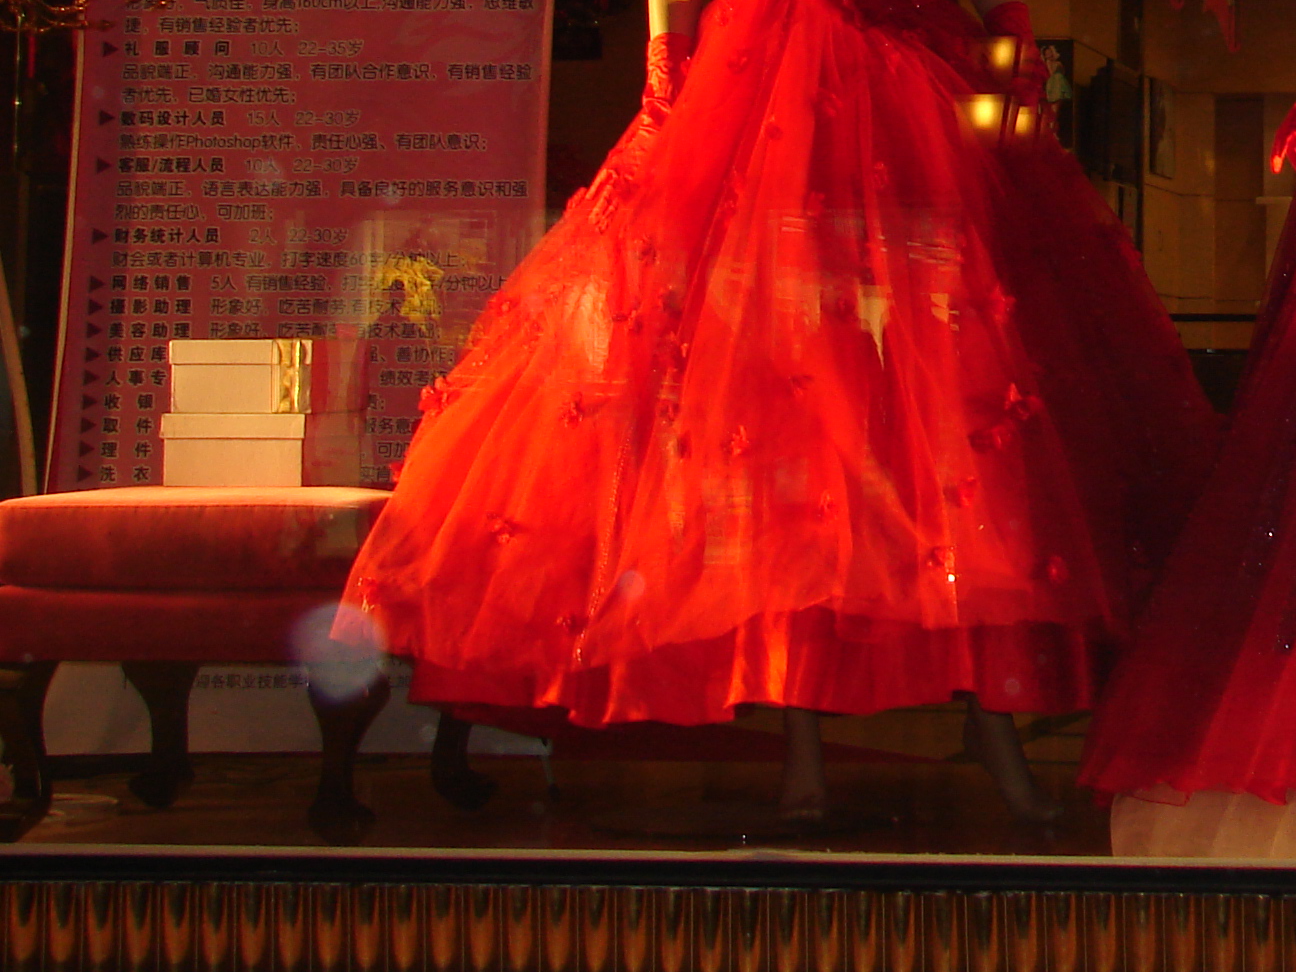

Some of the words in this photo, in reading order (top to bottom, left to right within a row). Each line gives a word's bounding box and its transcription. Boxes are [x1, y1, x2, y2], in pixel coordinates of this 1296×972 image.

[124, 40, 232, 57] 礼服顾问
[251, 40, 285, 57] 10人
[298, 39, 365, 57] 22-35岁
[119, 110, 227, 127] 数码设计人员
[247, 111, 282, 127] 15人
[295, 109, 362, 128] 22-30岁
[117, 156, 226, 174] 客服/流程人员
[244, 158, 281, 174] 10人
[293, 156, 360, 175] 22-30岁
[113, 227, 221, 245] 财务统计人员
[249, 229, 278, 245] 2人
[288, 227, 349, 246] 22-30岁
[110, 274, 193, 293] 网络销售
[211, 275, 238, 292] 5人
[109, 297, 193, 316] 摄影助理
[107, 321, 192, 339] 美容助理
[107, 345, 167, 364] 供应库
[105, 368, 168, 387] 人事专
[103, 392, 156, 411] 收银
[101, 416, 154, 436] 取件
[99, 440, 153, 460] 理件
[98, 464, 151, 483] 洗衣
